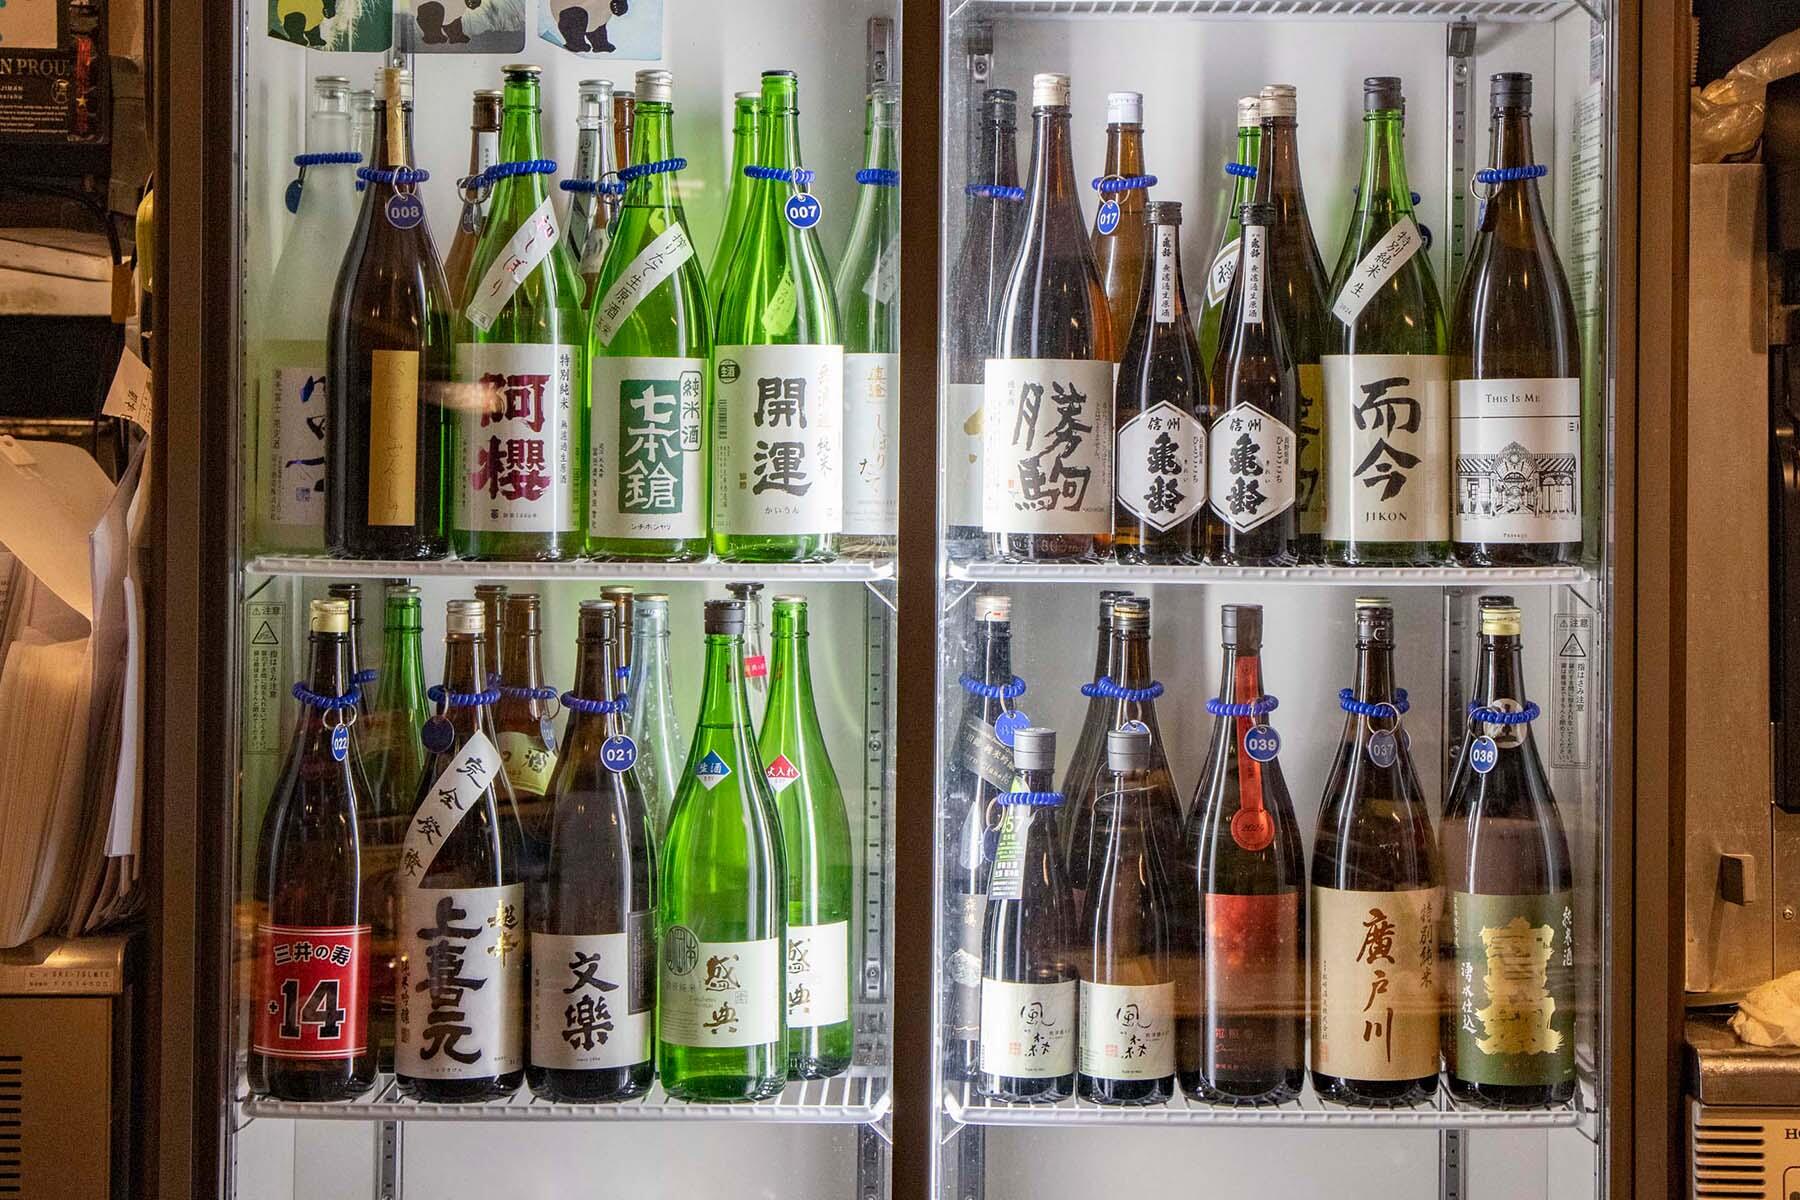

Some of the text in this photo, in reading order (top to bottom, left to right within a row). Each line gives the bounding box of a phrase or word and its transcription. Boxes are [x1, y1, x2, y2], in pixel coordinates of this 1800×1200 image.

[16, 58, 71, 76] PROU
[391, 206, 419, 219] 008
[789, 205, 818, 218] 007
[1100, 213, 1117, 225] 017
[560, 354, 570, 409] 特別純米
[682, 379, 700, 444] 純米酒
[1148, 417, 1181, 432] 信州
[1230, 418, 1263, 432] 信州
[753, 377, 813, 497] 開運
[1353, 377, 1422, 501] 而今
[620, 385, 681, 508] 七本鎗
[1012, 380, 1093, 512] 勝駒
[1366, 511, 1407, 523] JIKON
[262, 606, 281, 616] 注意
[1570, 618, 1588, 627] 注意
[334, 738, 347, 750] 022
[1249, 739, 1277, 751] 039
[607, 748, 632, 761] 021
[1420, 902, 1433, 988] 特別純米
[274, 942, 352, 966] 三井の寿
[416, 896, 487, 1064] 上喜元
[1356, 908, 1395, 1063] 廣戸川
